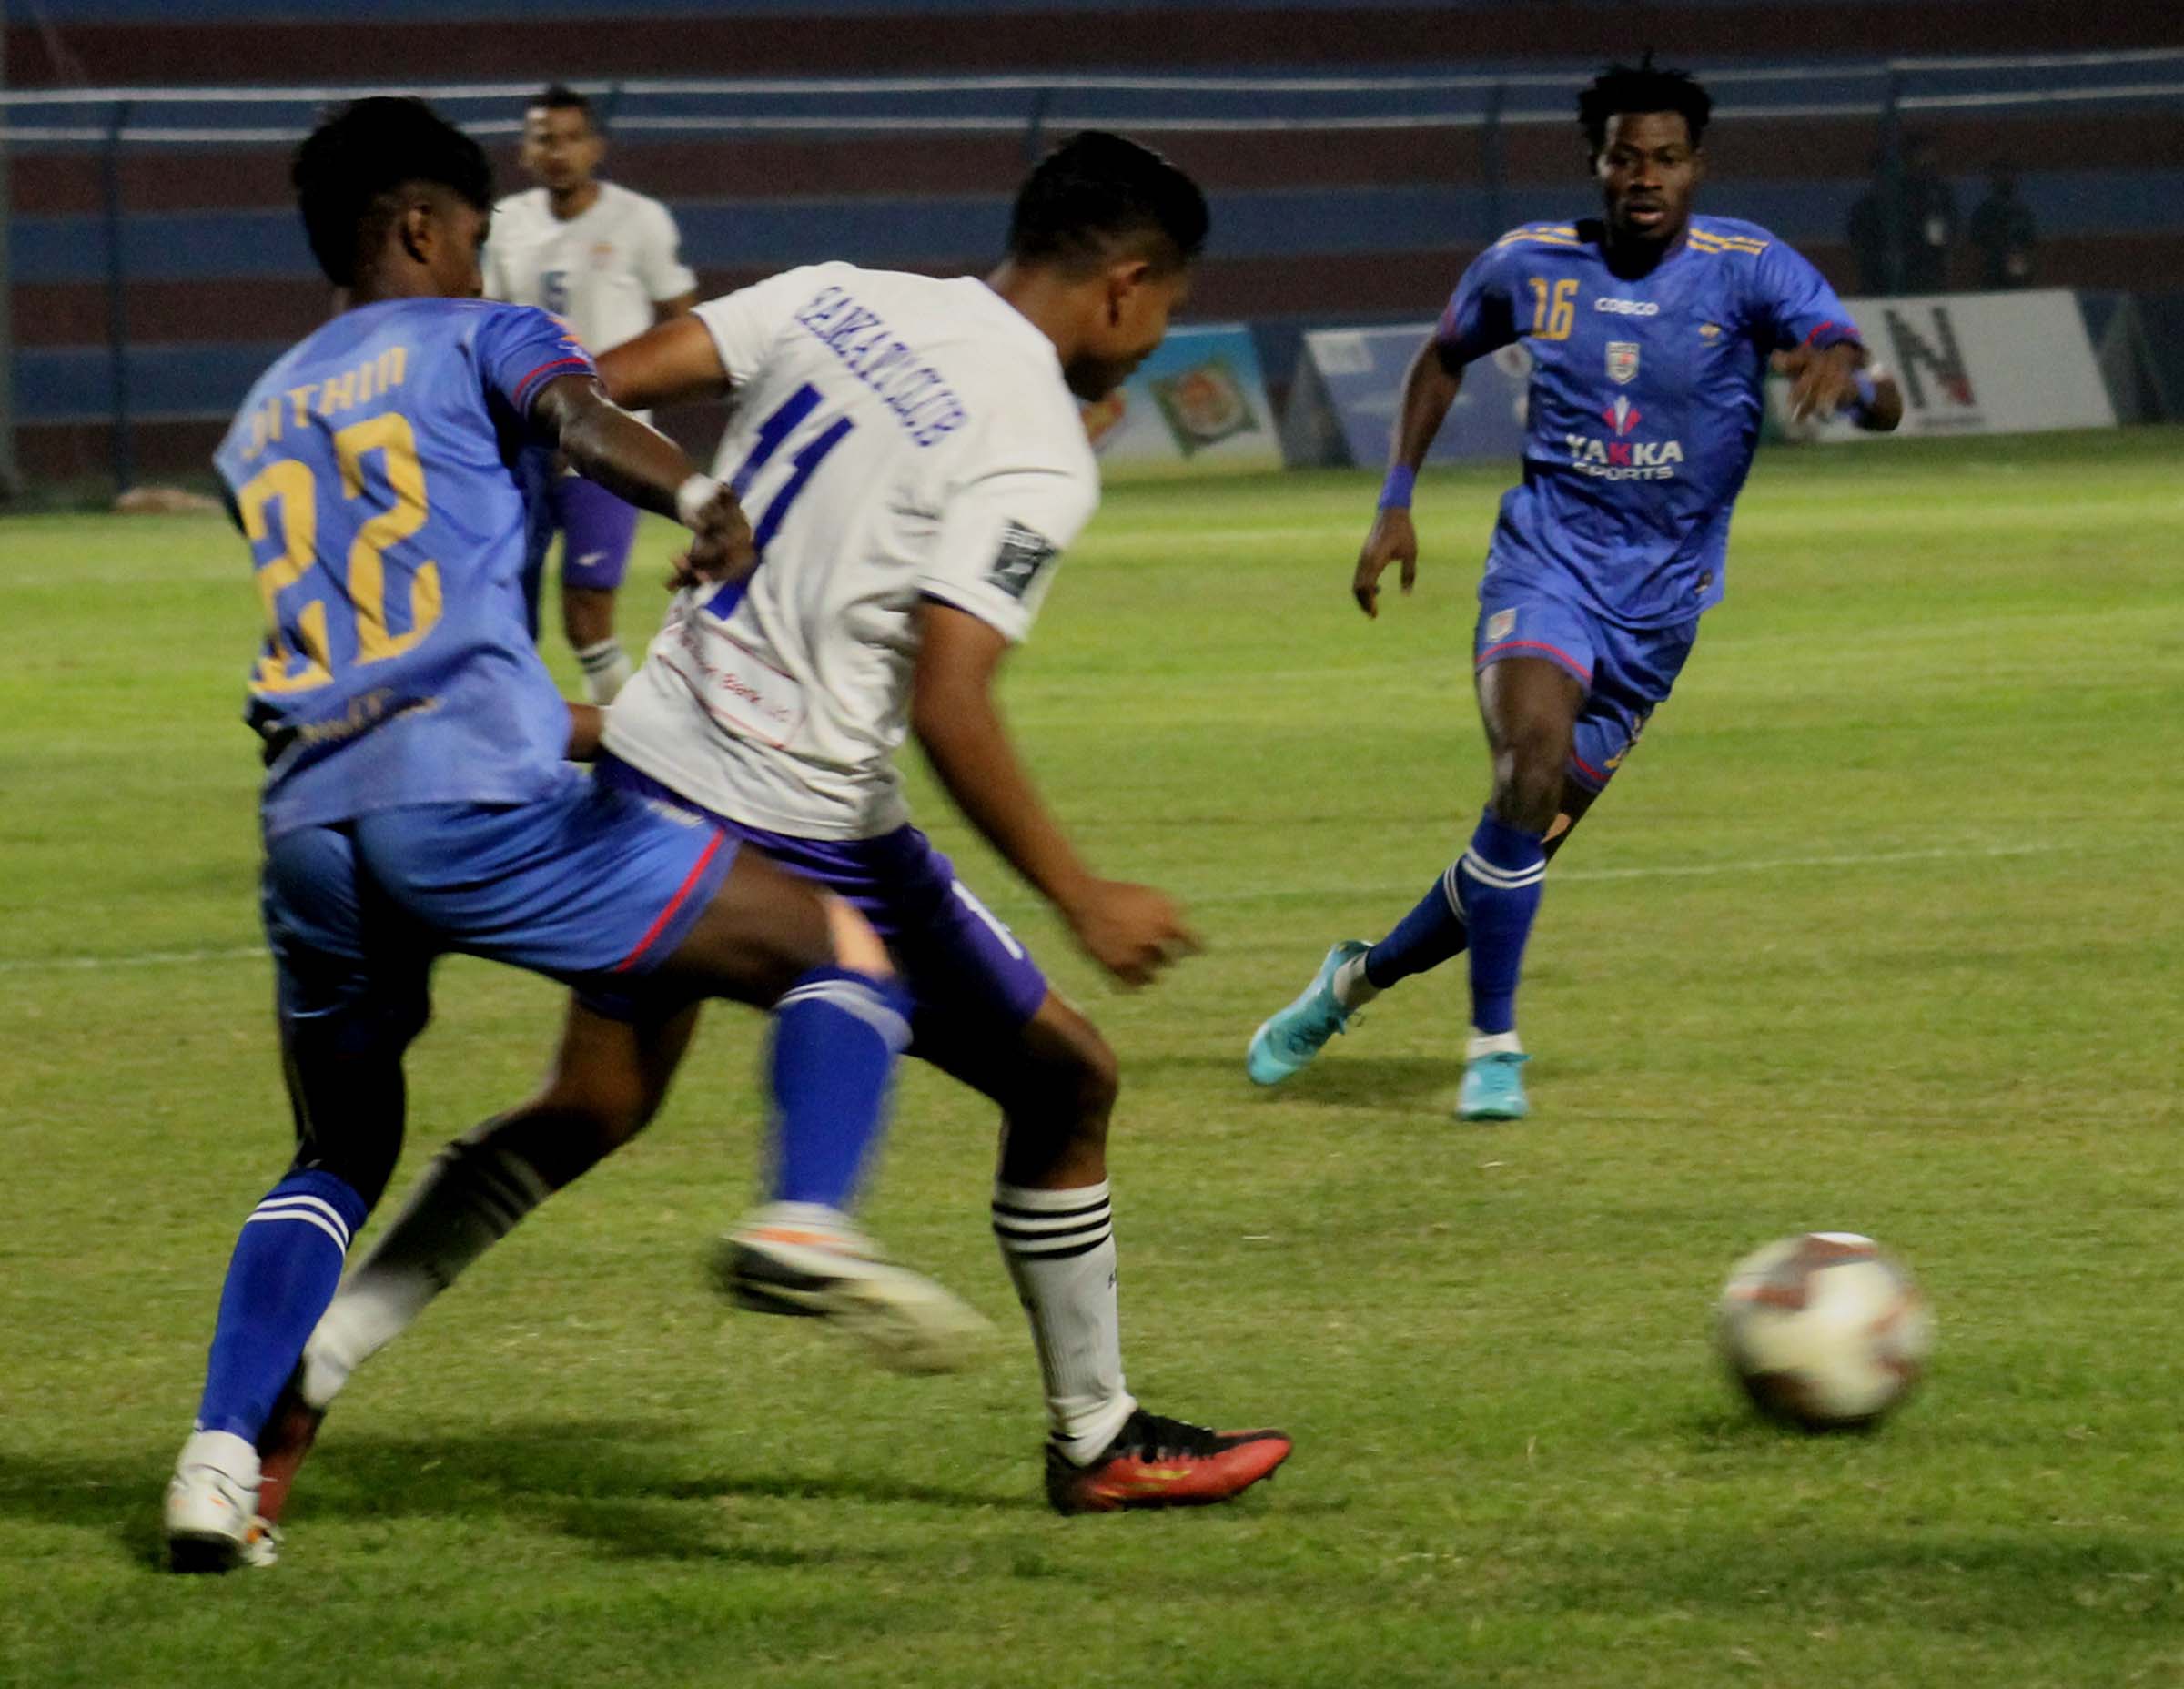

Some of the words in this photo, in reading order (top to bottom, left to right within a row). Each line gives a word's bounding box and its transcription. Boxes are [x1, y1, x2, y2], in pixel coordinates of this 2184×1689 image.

[1529, 277, 1580, 340] 16
[1565, 432, 1684, 466] YAKKA
[1572, 461, 1674, 481] SPORTS
[238, 411, 442, 694] 22
